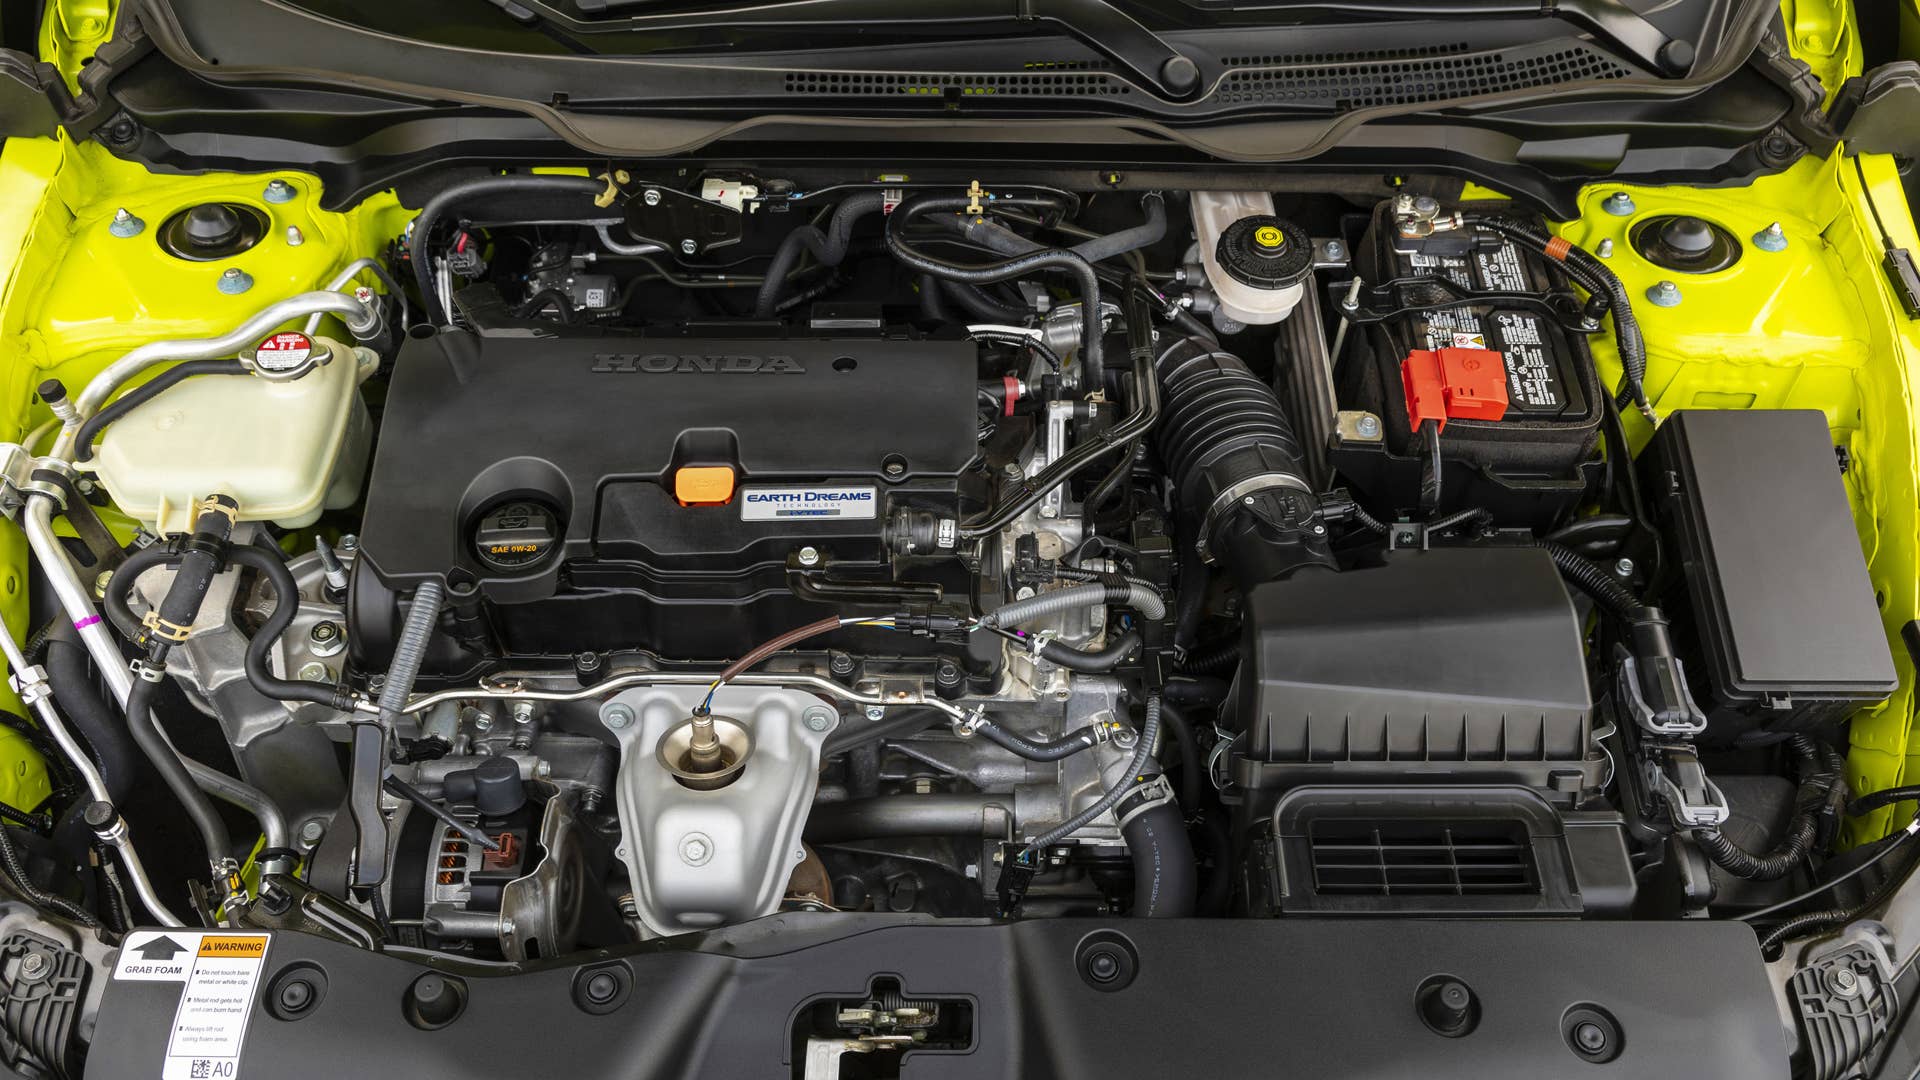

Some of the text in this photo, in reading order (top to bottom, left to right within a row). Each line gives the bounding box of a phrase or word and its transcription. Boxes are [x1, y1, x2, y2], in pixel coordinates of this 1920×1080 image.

[592, 353, 807, 374] HONDA
[747, 492, 872, 502] EARTH DREAMS
[214, 943, 262, 951] WARNING
[125, 966, 152, 974] GRAB
[212, 1061, 233, 1077] A0
